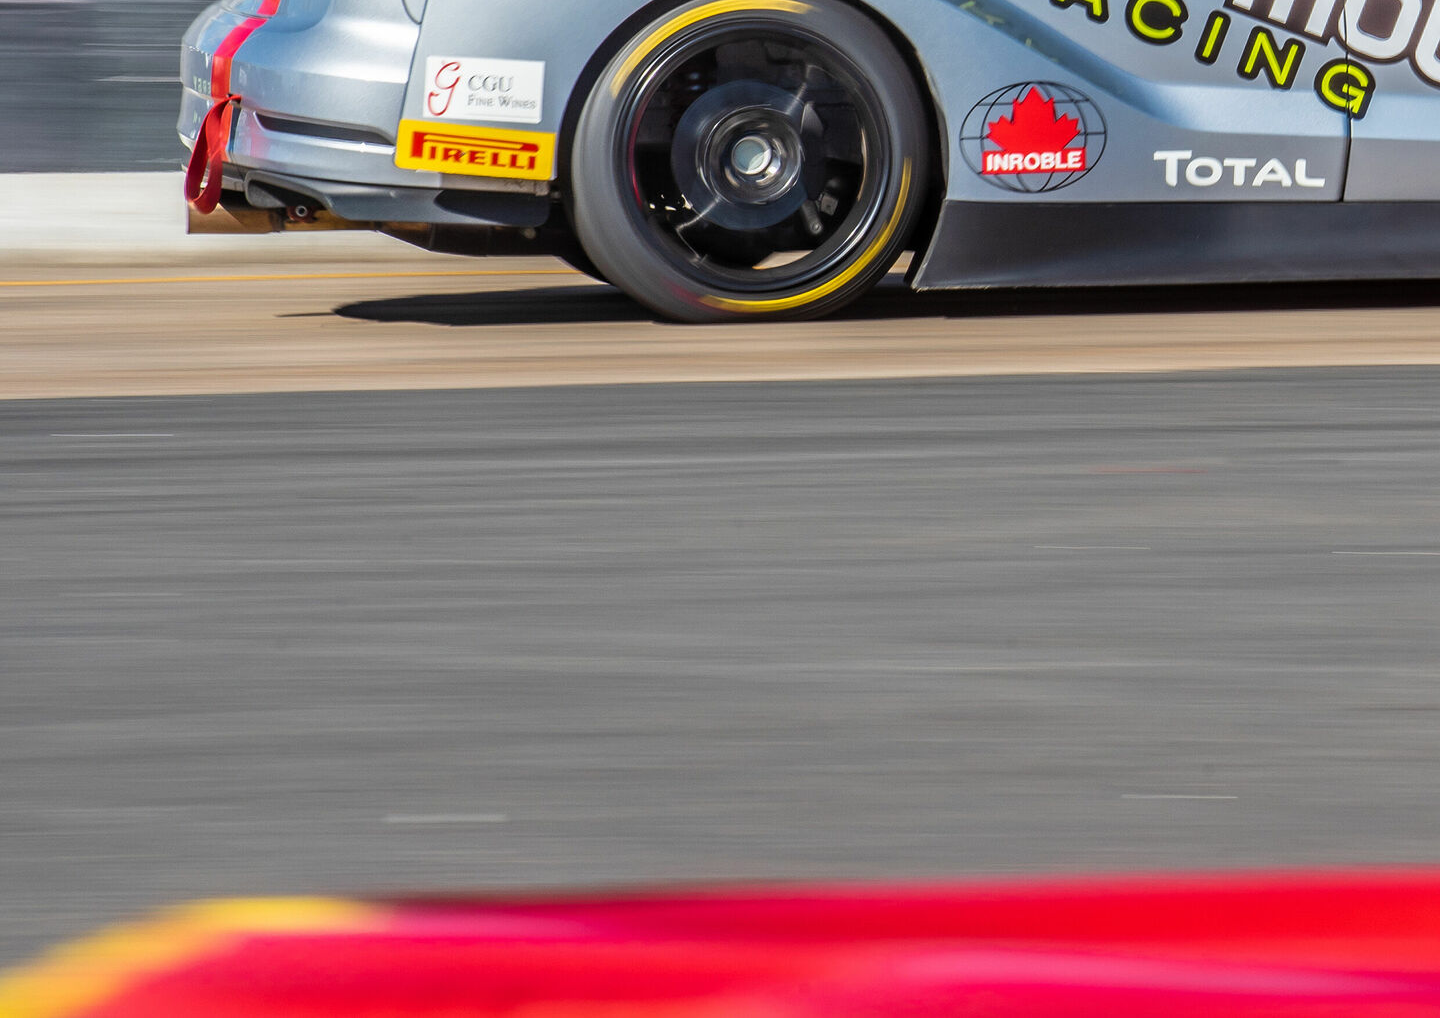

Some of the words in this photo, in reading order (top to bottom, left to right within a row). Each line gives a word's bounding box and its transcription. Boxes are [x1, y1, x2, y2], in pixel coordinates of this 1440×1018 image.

[468, 75, 514, 92] CGU
[410, 131, 539, 170] PIRELLI
[985, 149, 1084, 171] INROBLE
[1153, 150, 1326, 188] TOTAL
